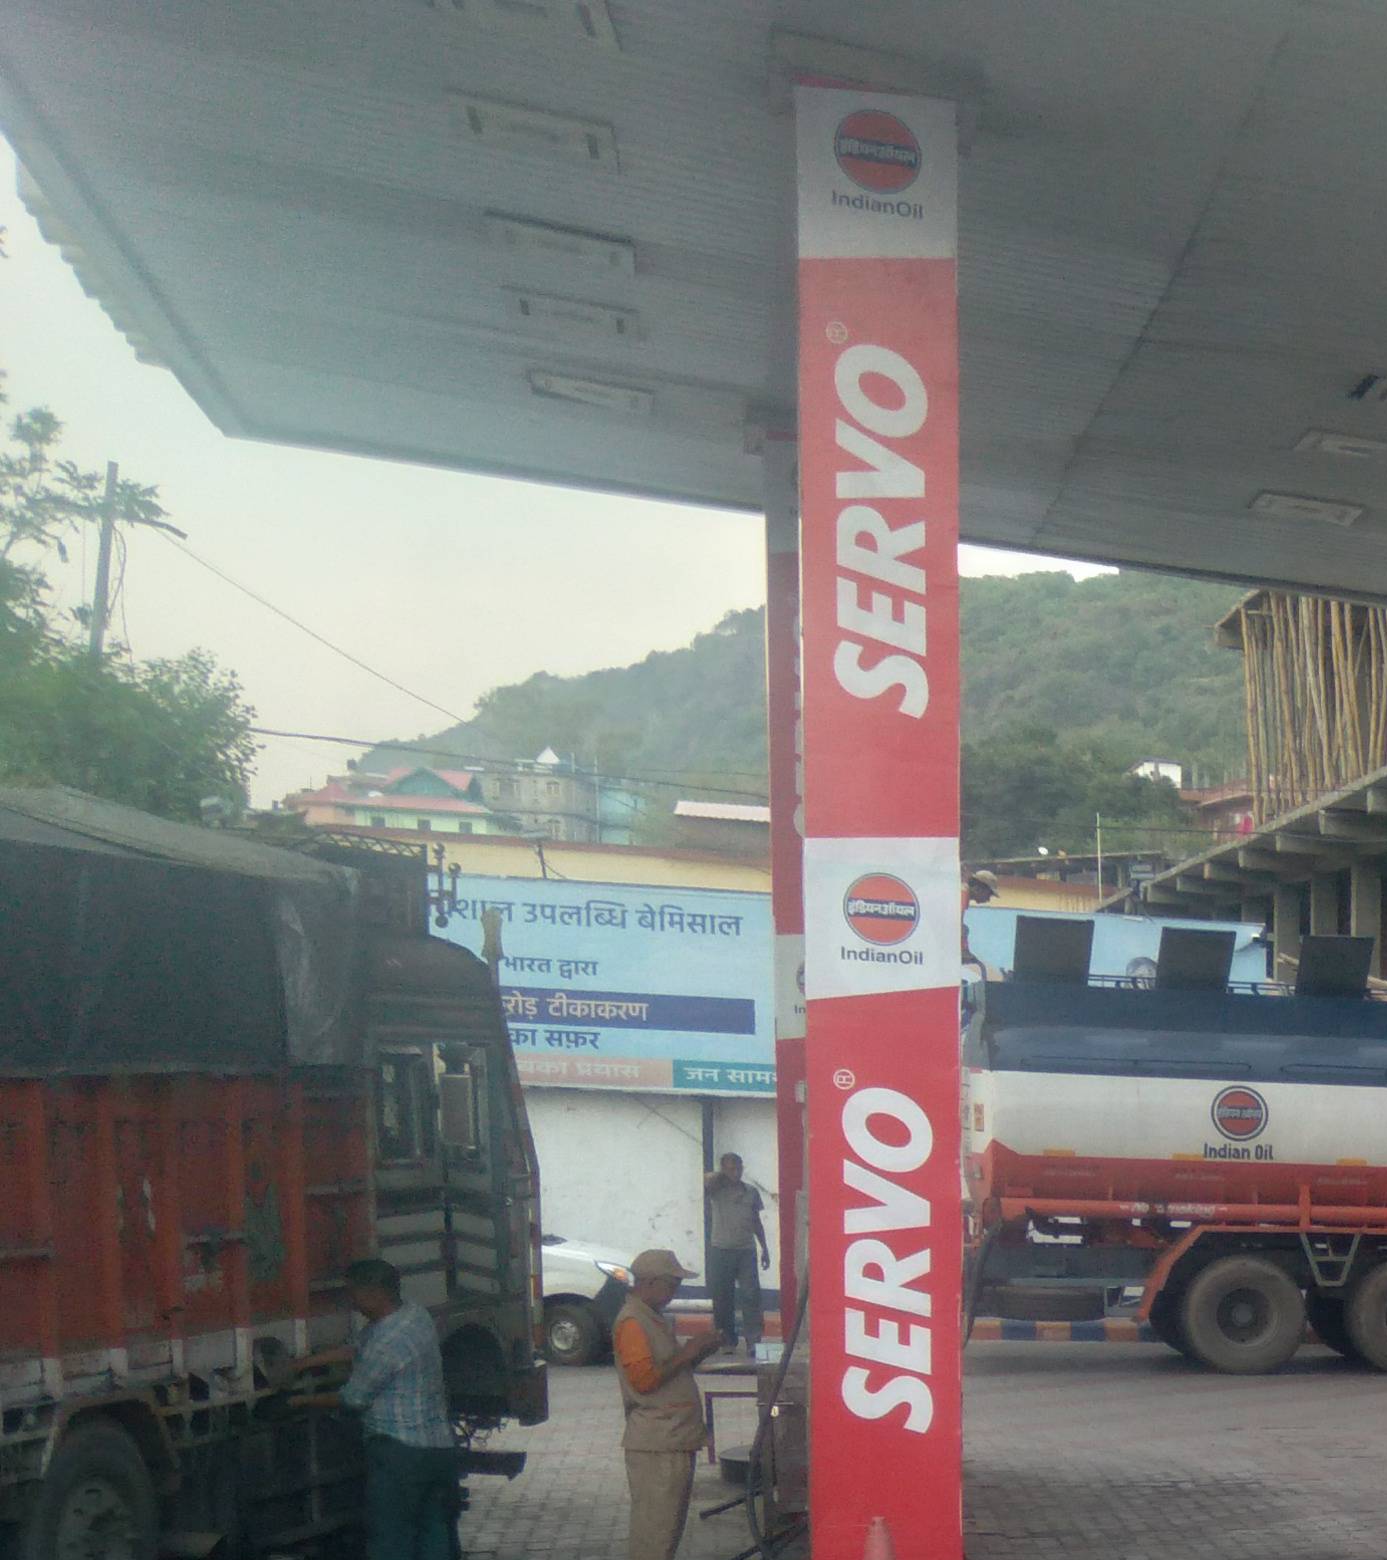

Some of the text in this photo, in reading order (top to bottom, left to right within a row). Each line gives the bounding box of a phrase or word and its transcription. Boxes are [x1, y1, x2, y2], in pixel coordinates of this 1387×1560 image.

[831, 189, 924, 219] IndianOil
[833, 345, 928, 719] SERVO
[635, 903, 744, 937] बेमिसाल
[841, 946, 924, 966] IndianOil
[546, 993, 649, 1022] टीकाकरण
[1204, 1142, 1274, 1160] Indian Oil
[841, 1087, 933, 1434] SERVO
